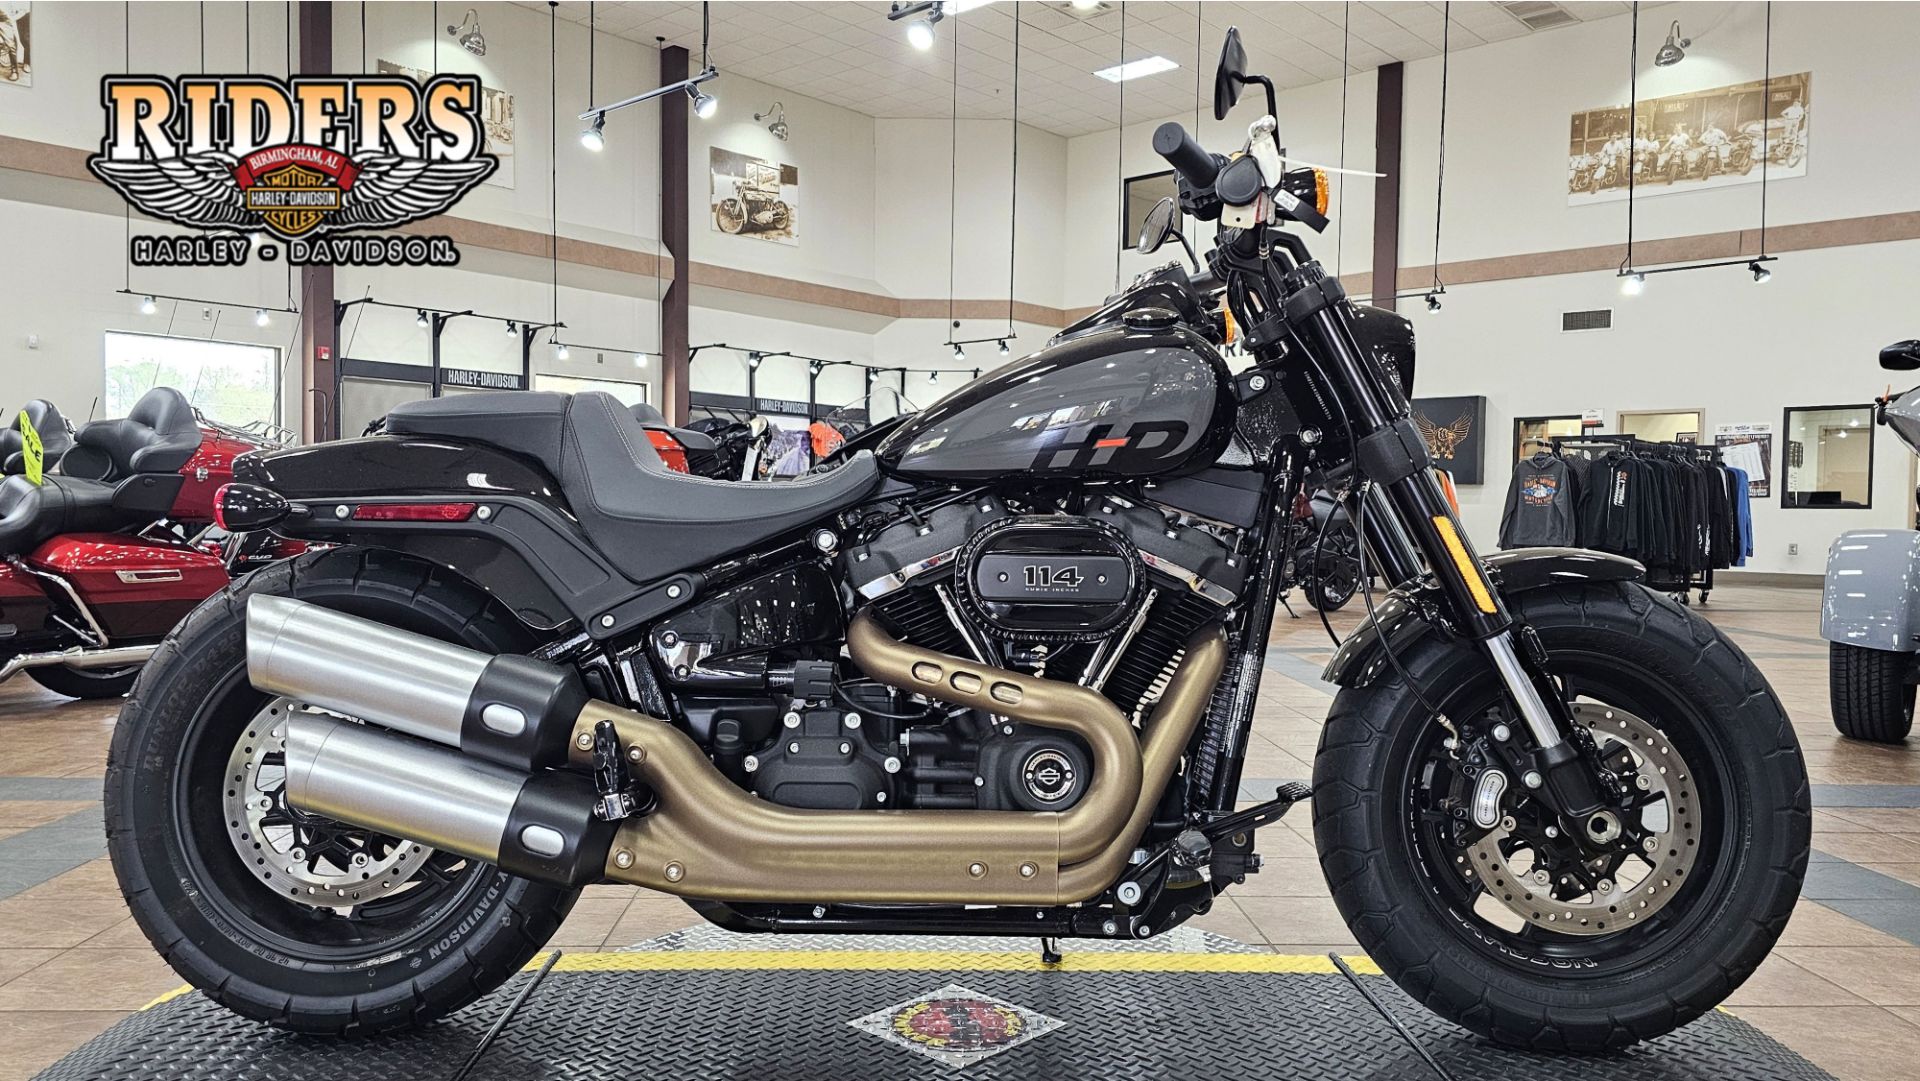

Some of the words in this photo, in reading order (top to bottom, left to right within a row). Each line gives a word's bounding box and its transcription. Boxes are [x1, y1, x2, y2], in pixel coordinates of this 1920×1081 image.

[447, 369, 520, 389] HARLEY-DAVIDSON
[760, 398, 809, 414] HARLEY-DAVIDSON
[1023, 565, 1085, 587] 114
